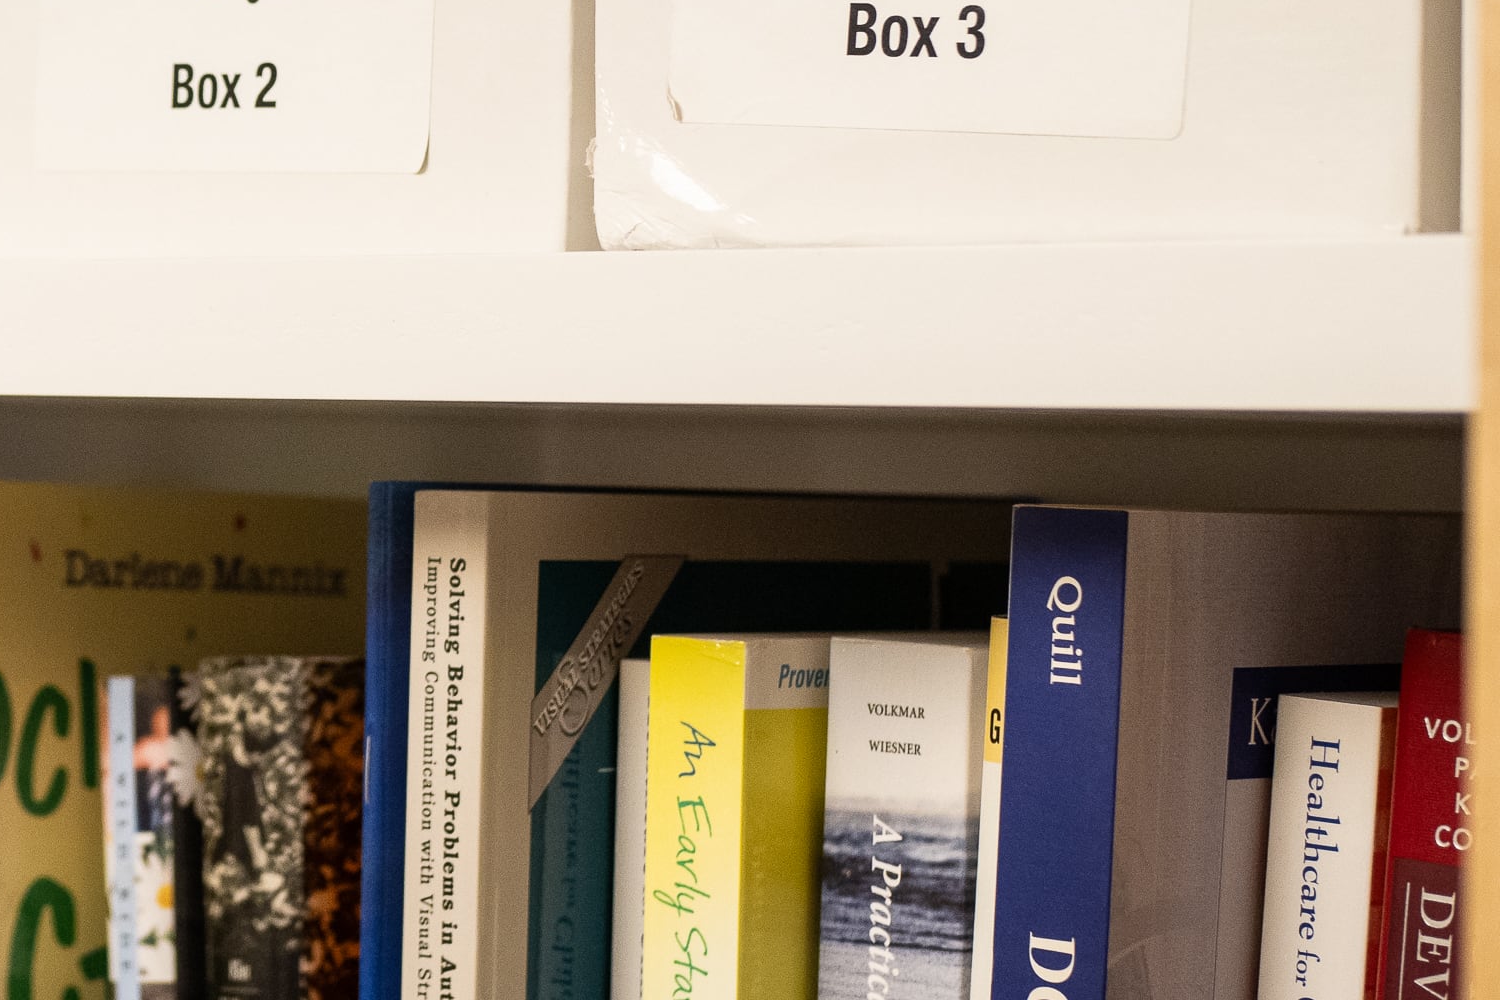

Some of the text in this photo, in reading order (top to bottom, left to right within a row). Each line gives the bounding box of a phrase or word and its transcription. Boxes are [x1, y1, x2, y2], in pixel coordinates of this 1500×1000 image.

[846, 2, 986, 59] Box 3
[172, 62, 278, 109] Box 2
[64, 550, 348, 596] Darlene Mannix
[444, 557, 466, 654] Solving
[422, 557, 442, 664] Improving
[1047, 575, 1082, 685] Quill
[533, 560, 645, 736] VISUAL STRATEGIES
[558, 610, 631, 736] Series
[445, 664, 464, 780] Behavior
[867, 703, 925, 719] VOLKMAR
[1248, 697, 1275, 745] K
[421, 671, 439, 831] Communication
[869, 740, 921, 755] WIESNER
[420, 840, 434, 885] with
[442, 790, 461, 911] Problems
[653, 721, 716, 1000] An Early Sta
[873, 814, 902, 846] A
[1298, 736, 1341, 941] Healthcare
[418, 894, 434, 959] Visual
[441, 920, 458, 945] in
[1027, 931, 1075, 1000] D
[1295, 949, 1320, 987] for
